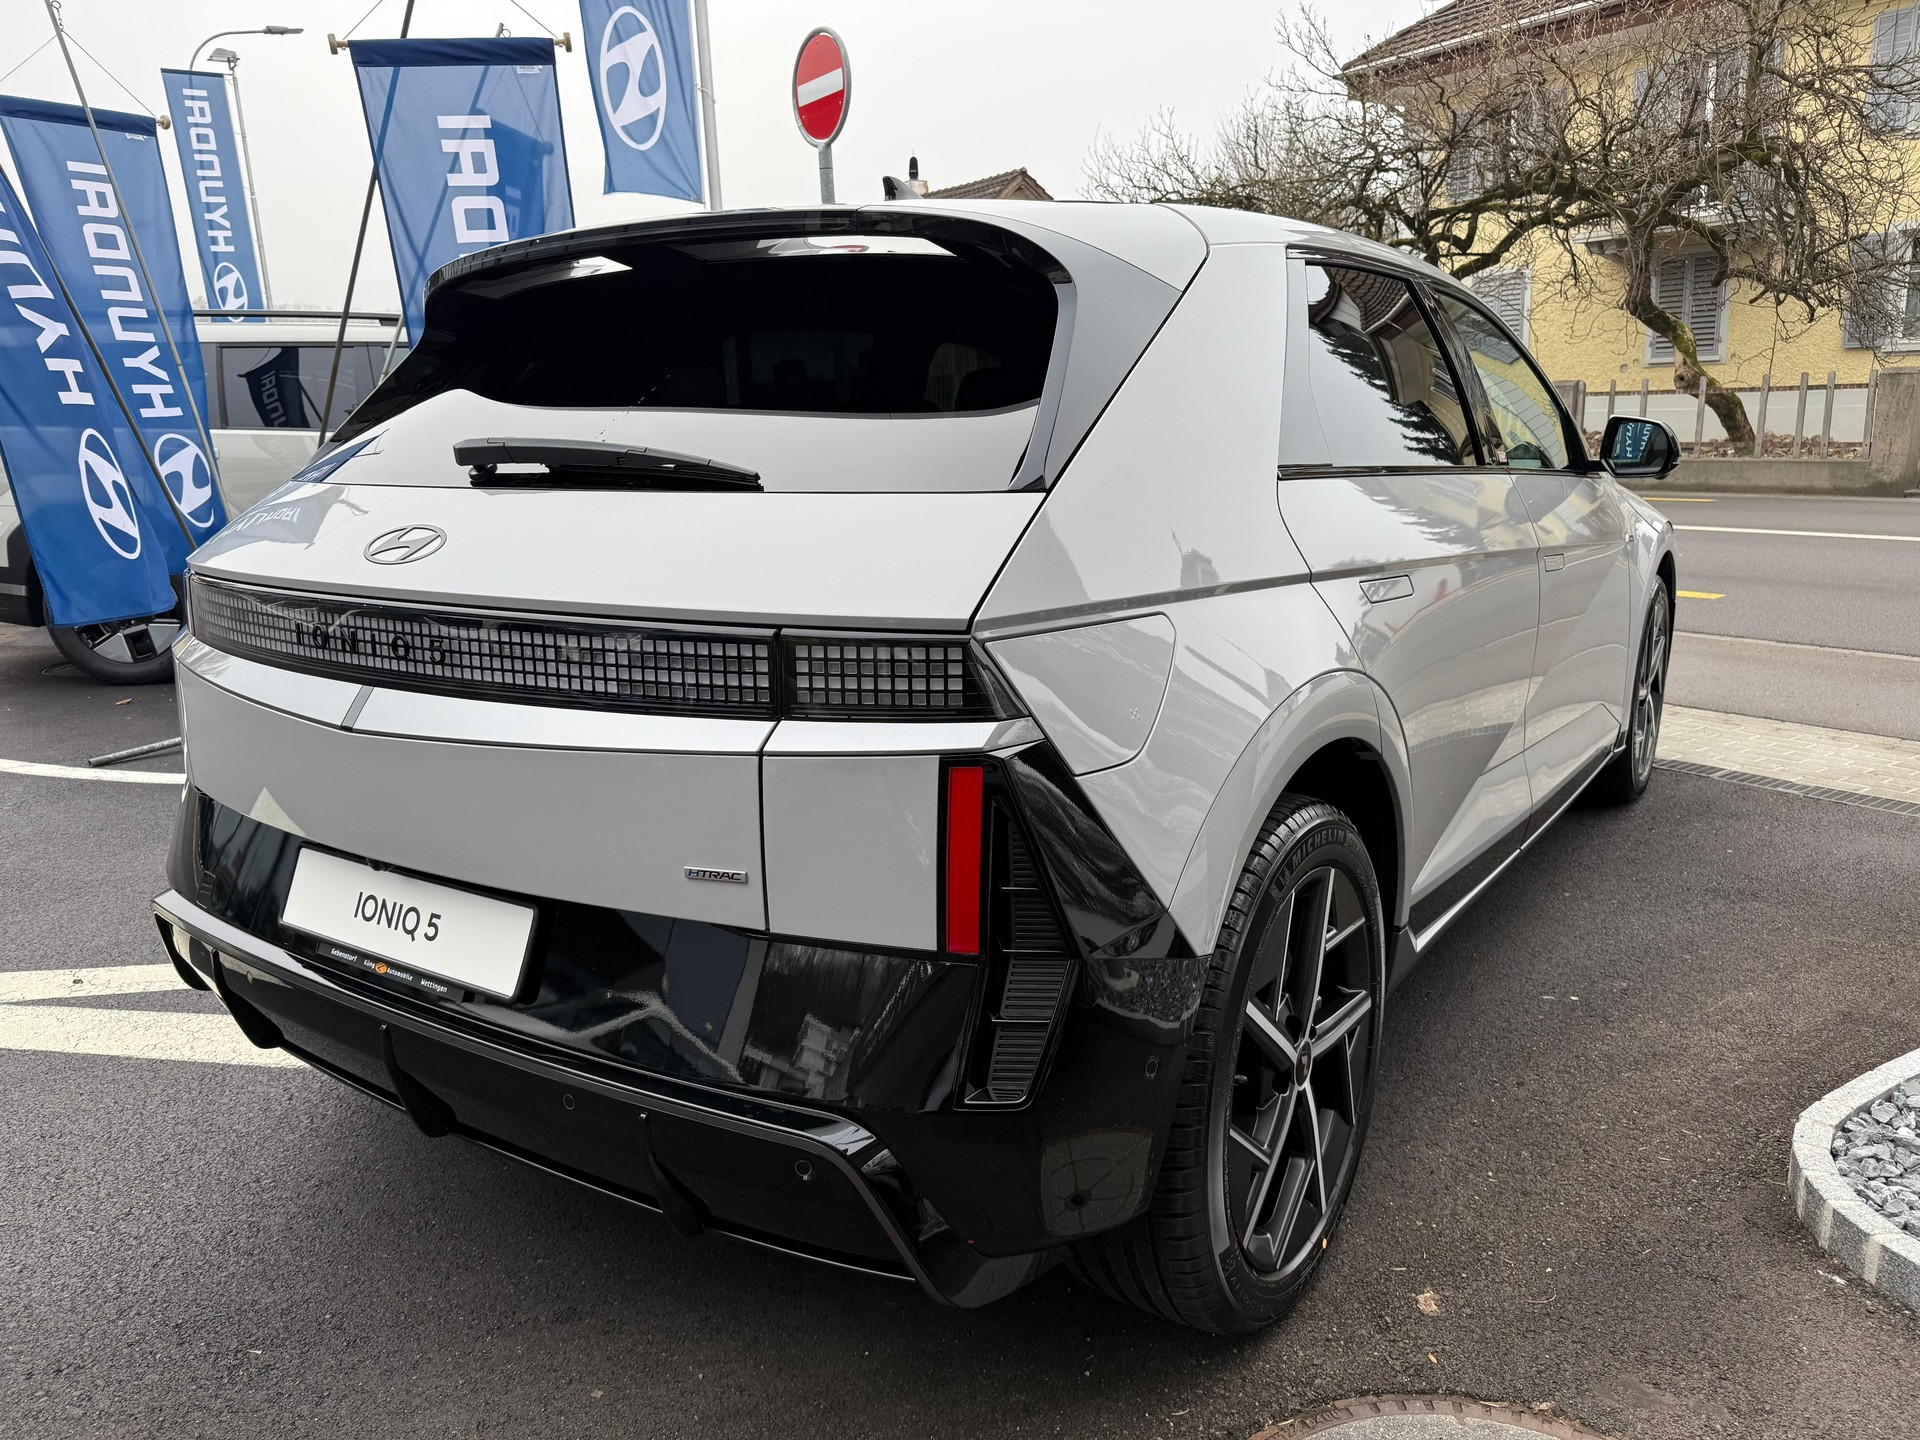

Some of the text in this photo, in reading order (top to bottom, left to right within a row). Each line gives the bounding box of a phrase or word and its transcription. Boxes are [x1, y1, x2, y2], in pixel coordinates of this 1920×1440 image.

[296, 622, 446, 664] IONIQ 5
[1292, 828, 1345, 871] MICHELIN
[688, 868, 742, 881] HTRAC
[354, 891, 442, 942] IONIQ 5
[331, 948, 358, 962] Gebenstorf
[386, 967, 414, 981] Automobile
[420, 978, 448, 993] Wettingen
